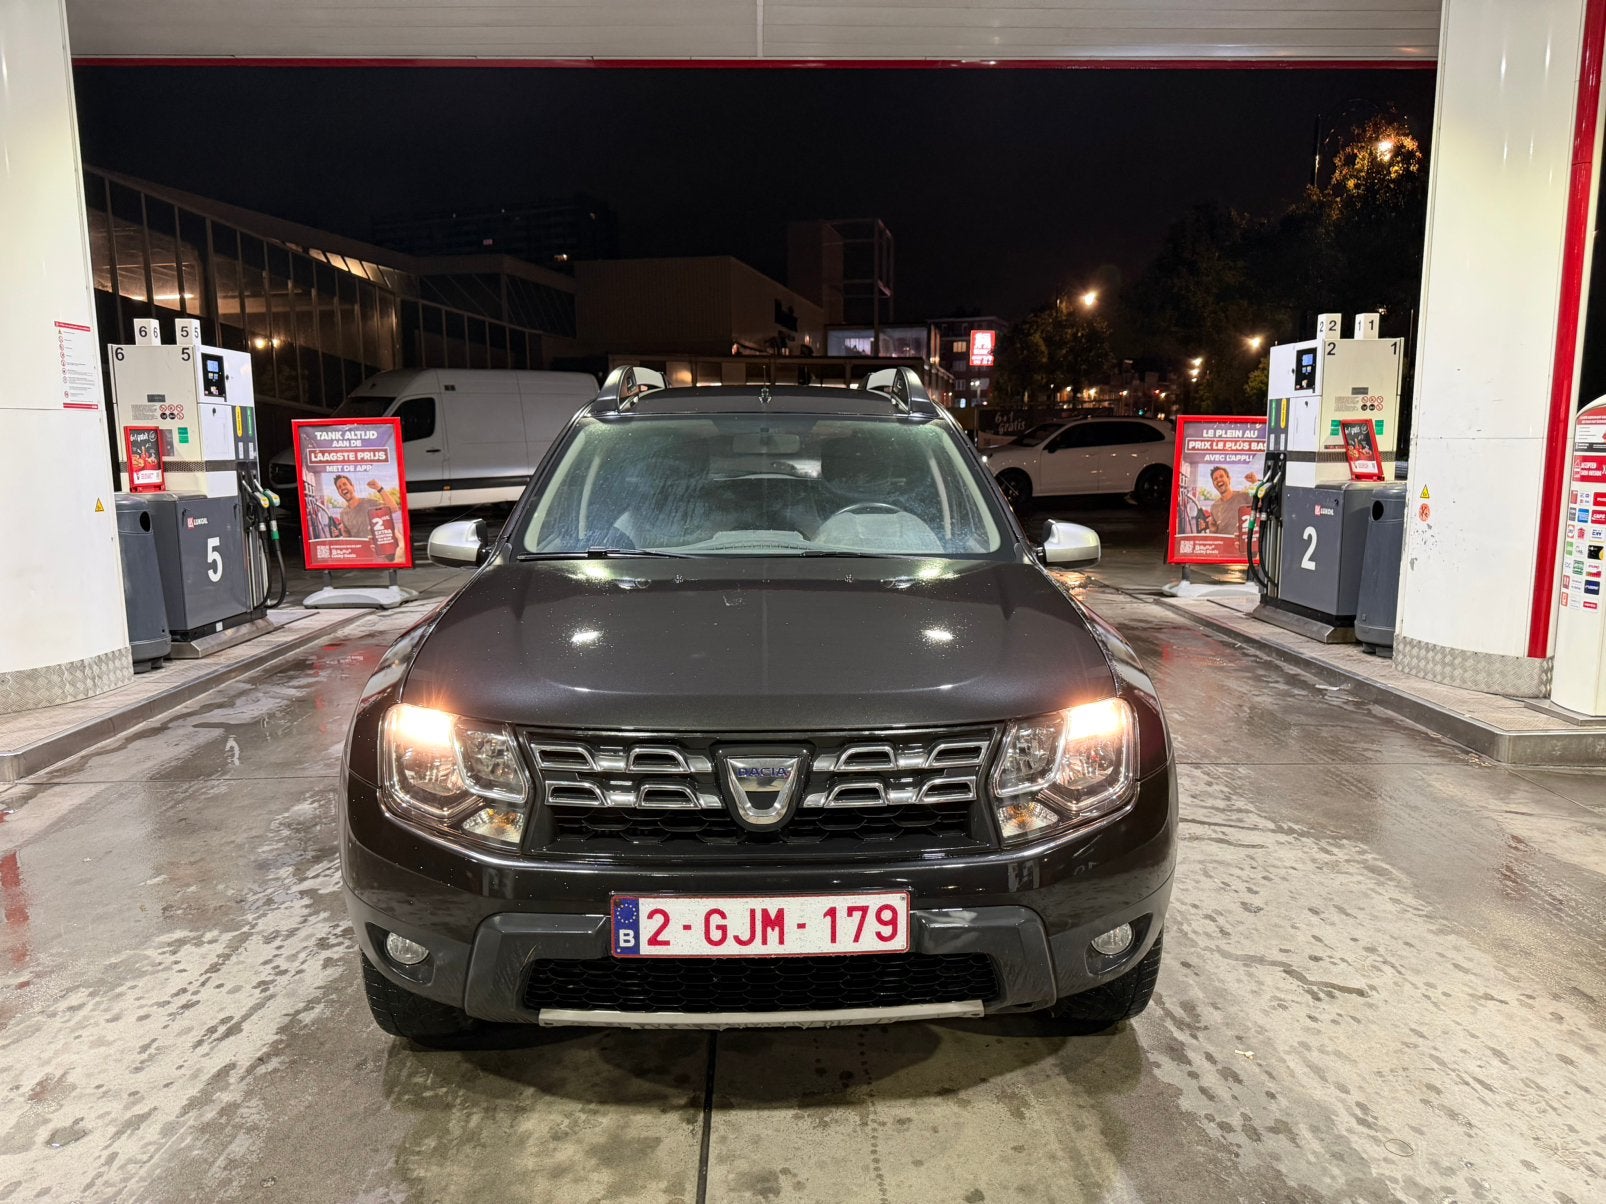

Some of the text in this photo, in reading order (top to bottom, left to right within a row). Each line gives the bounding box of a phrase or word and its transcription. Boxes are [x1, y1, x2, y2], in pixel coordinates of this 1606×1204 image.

[1320, 321, 1324, 332] 2
[1329, 320, 1337, 331] 2
[1368, 319, 1374, 331] 1
[138, 326, 148, 338] 6
[153, 327, 158, 338] 6
[180, 326, 189, 338] 5
[194, 327, 199, 338] 5
[115, 347, 125, 361] 6
[181, 347, 191, 361] 5
[1327, 342, 1336, 356] 2
[1390, 341, 1398, 355] 1
[315, 431, 378, 440] TANK ALTIJD
[1203, 429, 1258, 438] LE PLEIN AU
[1188, 441, 1212, 450] PRIX
[1213, 441, 1224, 450] LE
[1225, 441, 1250, 450] PLUS
[311, 451, 386, 461] LAAGSTE PRIJS
[372, 518, 385, 530] 2
[1301, 526, 1317, 571] 2
[207, 537, 223, 583] 5
[737, 767, 787, 777] DACIA
[647, 904, 898, 947] 2-GJM-179
[619, 929, 635, 947] B
